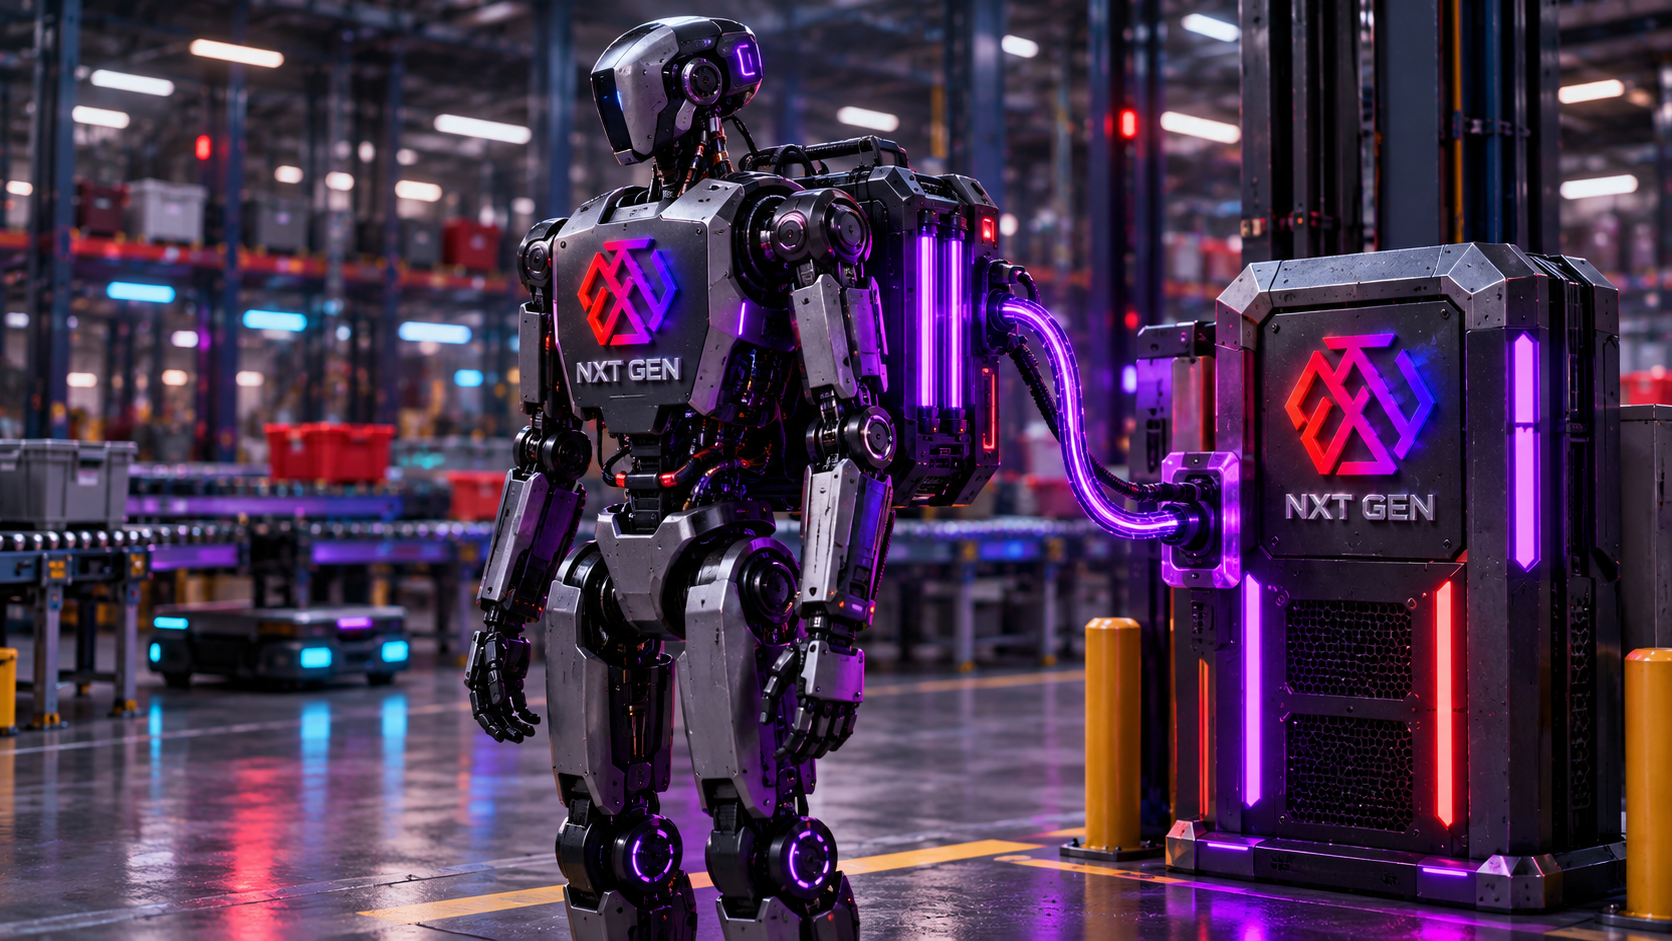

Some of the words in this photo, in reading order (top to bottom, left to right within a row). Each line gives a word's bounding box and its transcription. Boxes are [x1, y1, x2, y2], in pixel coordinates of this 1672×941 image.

[576, 360, 623, 383] NXT
[628, 357, 681, 381] GEN
[1285, 493, 1354, 520] NXT
[1362, 494, 1435, 521] GEN
